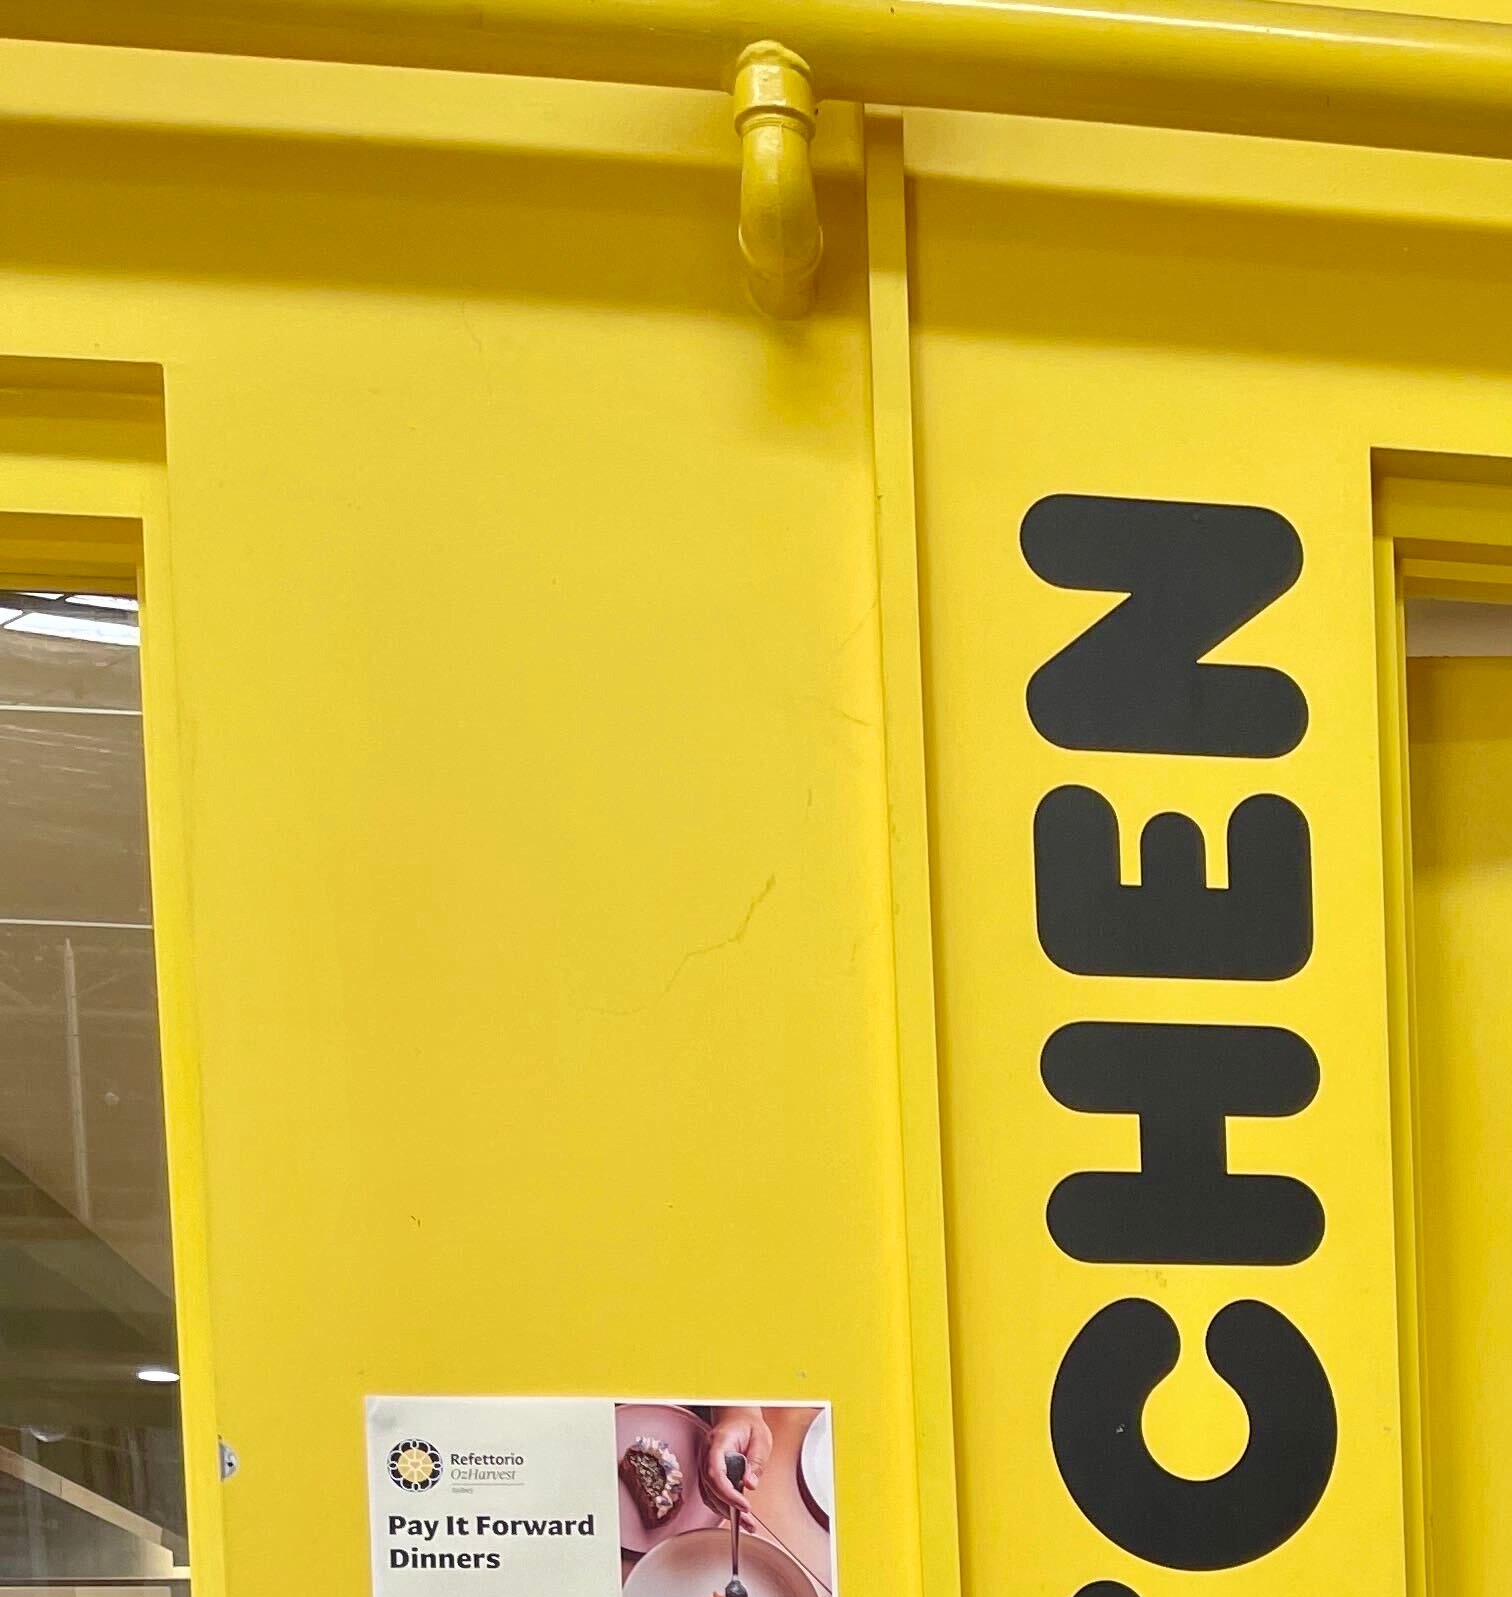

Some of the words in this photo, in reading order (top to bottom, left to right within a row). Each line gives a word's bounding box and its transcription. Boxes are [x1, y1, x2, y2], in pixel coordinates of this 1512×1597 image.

[451, 1453, 524, 1466] Refettorio
[451, 1469, 516, 1480] OzHarvest
[389, 1516, 438, 1541] Pay
[448, 1516, 469, 1535] It
[477, 1515, 594, 1535] Forward
[390, 1548, 500, 1569] Dinners
